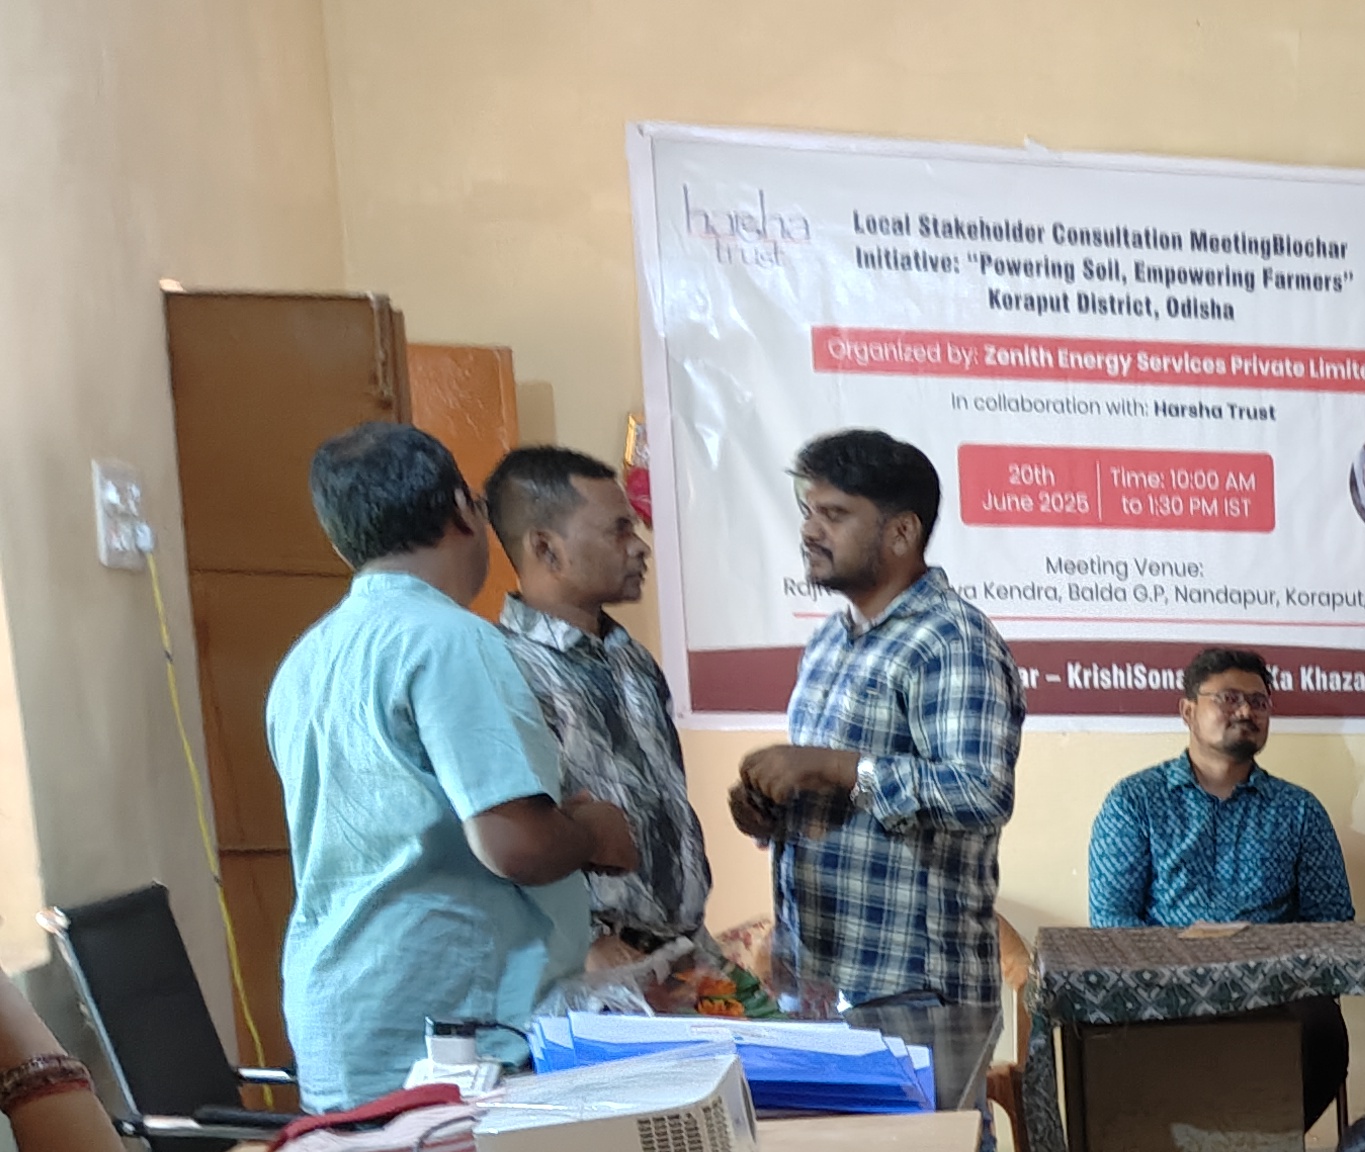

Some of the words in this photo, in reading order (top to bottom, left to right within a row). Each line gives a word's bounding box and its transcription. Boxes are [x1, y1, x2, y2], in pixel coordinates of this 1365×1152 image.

[852, 209, 911, 236] Local
[918, 215, 1045, 244] Stakeholder
[1052, 222, 1183, 251] Consultation
[1189, 230, 1348, 261] MeetingBiochar
[855, 245, 960, 274] Initiative:
[1082, 258, 1127, 286] Soil,
[1134, 261, 1256, 293] Empowering
[988, 287, 1070, 317] Koraput
[1076, 291, 1160, 320] District,
[1166, 296, 1235, 321] Odisha
[827, 334, 942, 367] Organized
[946, 341, 979, 371] by:
[984, 344, 1054, 368] Zenith
[1057, 348, 1133, 377] Energy
[1136, 350, 1227, 375] Services
[1230, 353, 1305, 378] Private
[951, 392, 969, 410] In
[973, 393, 1102, 416] collaboration
[1105, 398, 1149, 417] with:
[1153, 400, 1223, 420] Harsha
[1227, 403, 1276, 422] Trust
[1008, 463, 1056, 487] 20th
[1110, 465, 1165, 489] Time:
[1169, 468, 1220, 491] 10:00
[1225, 471, 1256, 491] AM
[982, 489, 1034, 513] June
[1038, 490, 1090, 514] 2025
[1121, 495, 1143, 515] to
[1147, 493, 1184, 517] 1:30
[1189, 495, 1220, 518] PM
[1223, 497, 1252, 519] IST
[1045, 555, 1129, 582] Meeting
[1133, 557, 1204, 578] Venue:
[983, 581, 1063, 604] Kendra,
[1067, 581, 1127, 603] Balda
[1132, 583, 1169, 606] G.P,
[1174, 584, 1281, 610] Nandapur,
